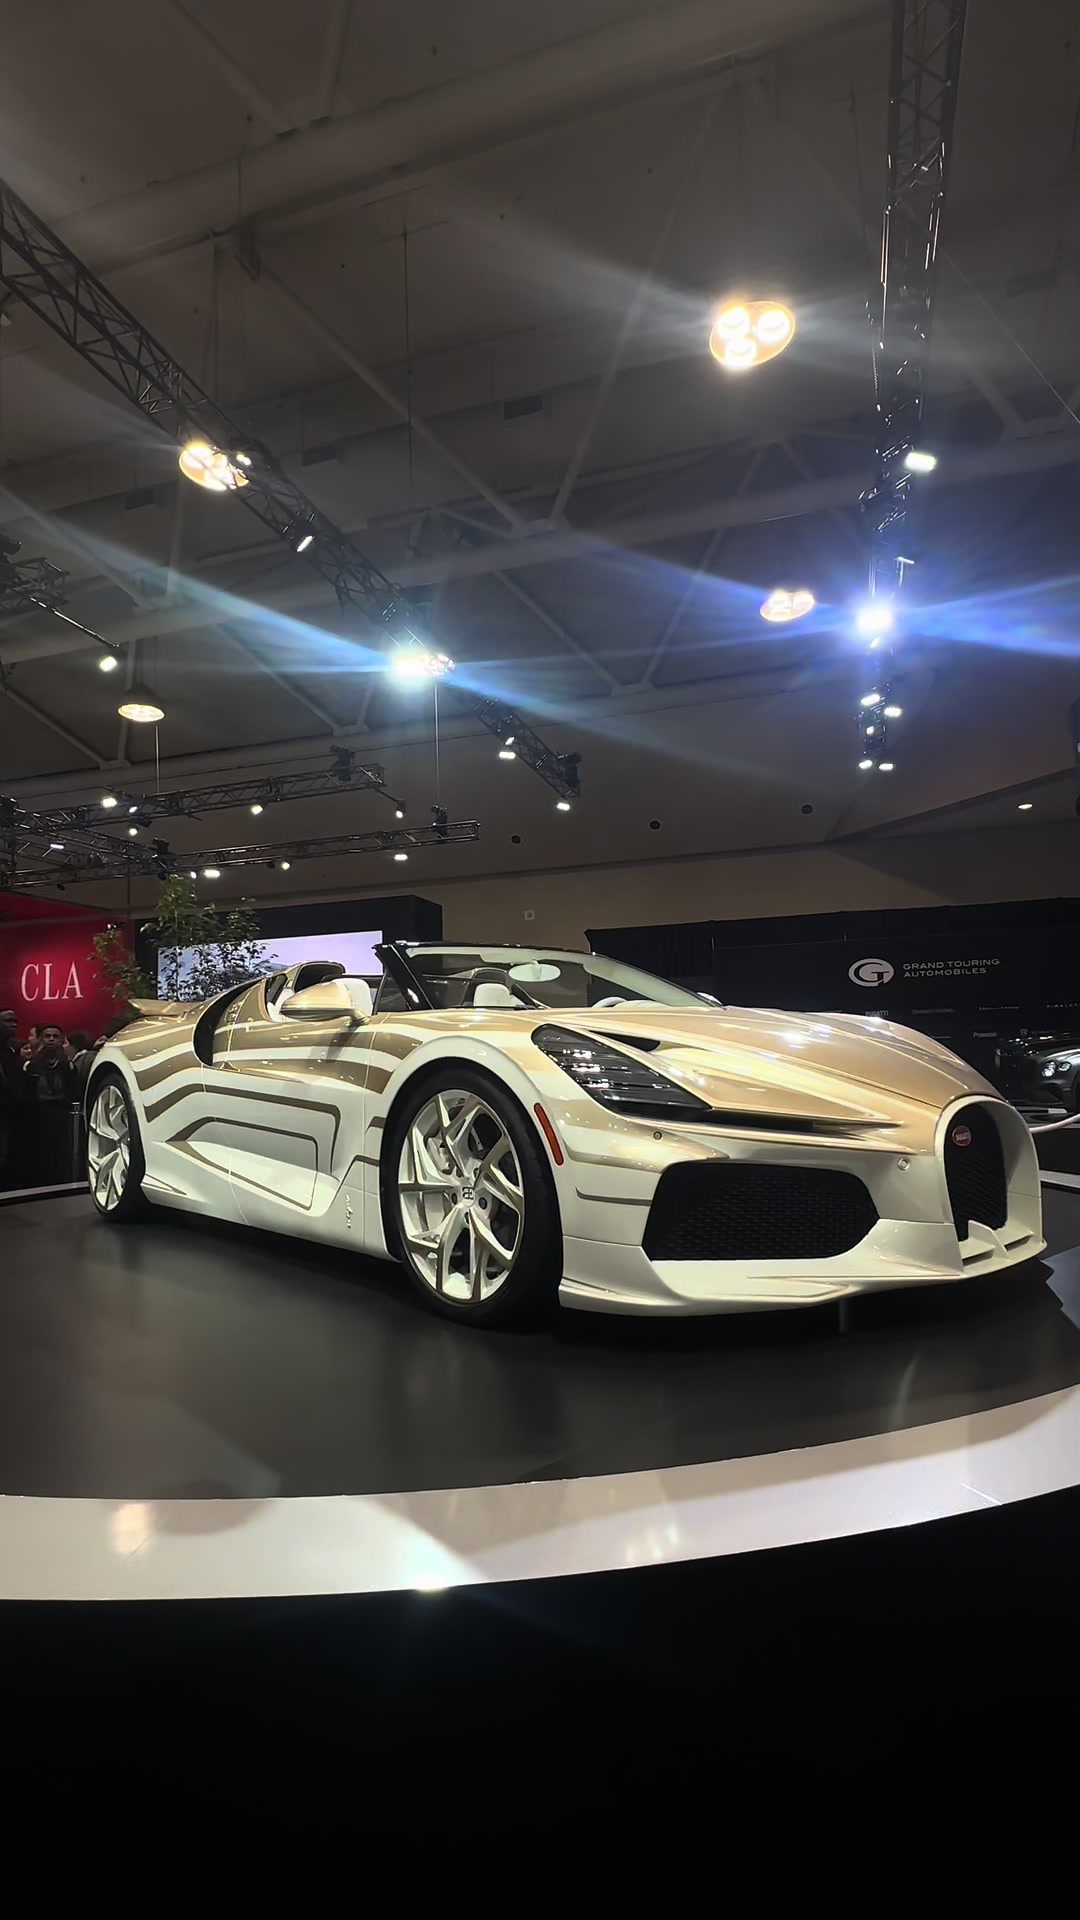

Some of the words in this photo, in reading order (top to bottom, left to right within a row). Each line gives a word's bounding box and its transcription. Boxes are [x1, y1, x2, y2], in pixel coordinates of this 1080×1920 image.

[902, 961, 945, 971] GRAND
[946, 957, 1001, 968] TOURING
[903, 967, 987, 978] AUTOMOBILES
[21, 960, 84, 1002] CLA
